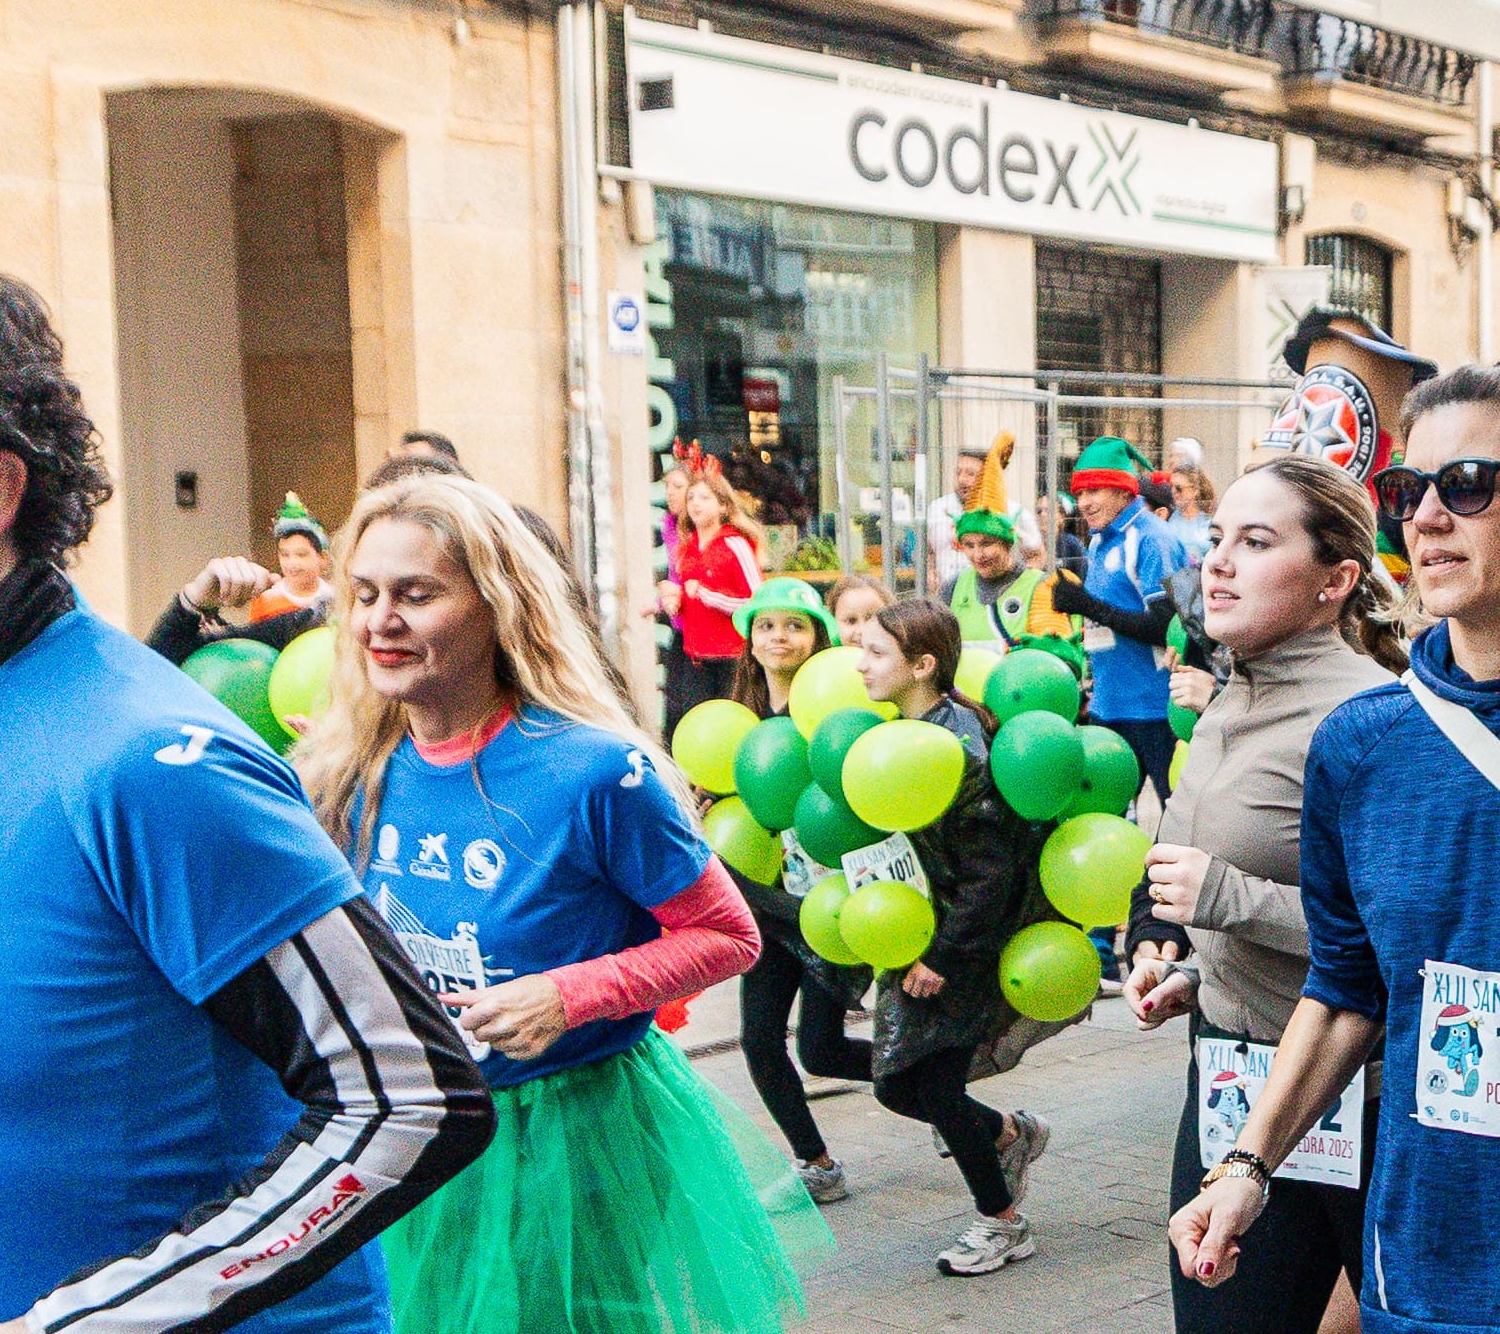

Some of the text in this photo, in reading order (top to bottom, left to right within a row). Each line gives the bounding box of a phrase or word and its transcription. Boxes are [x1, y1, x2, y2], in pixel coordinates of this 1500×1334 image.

[407, 938, 472, 974] SILVESTRE
[1433, 972, 1466, 1005] XLII
[1240, 1053, 1269, 1079] SAN
[1329, 1137, 1354, 1160] 2025
